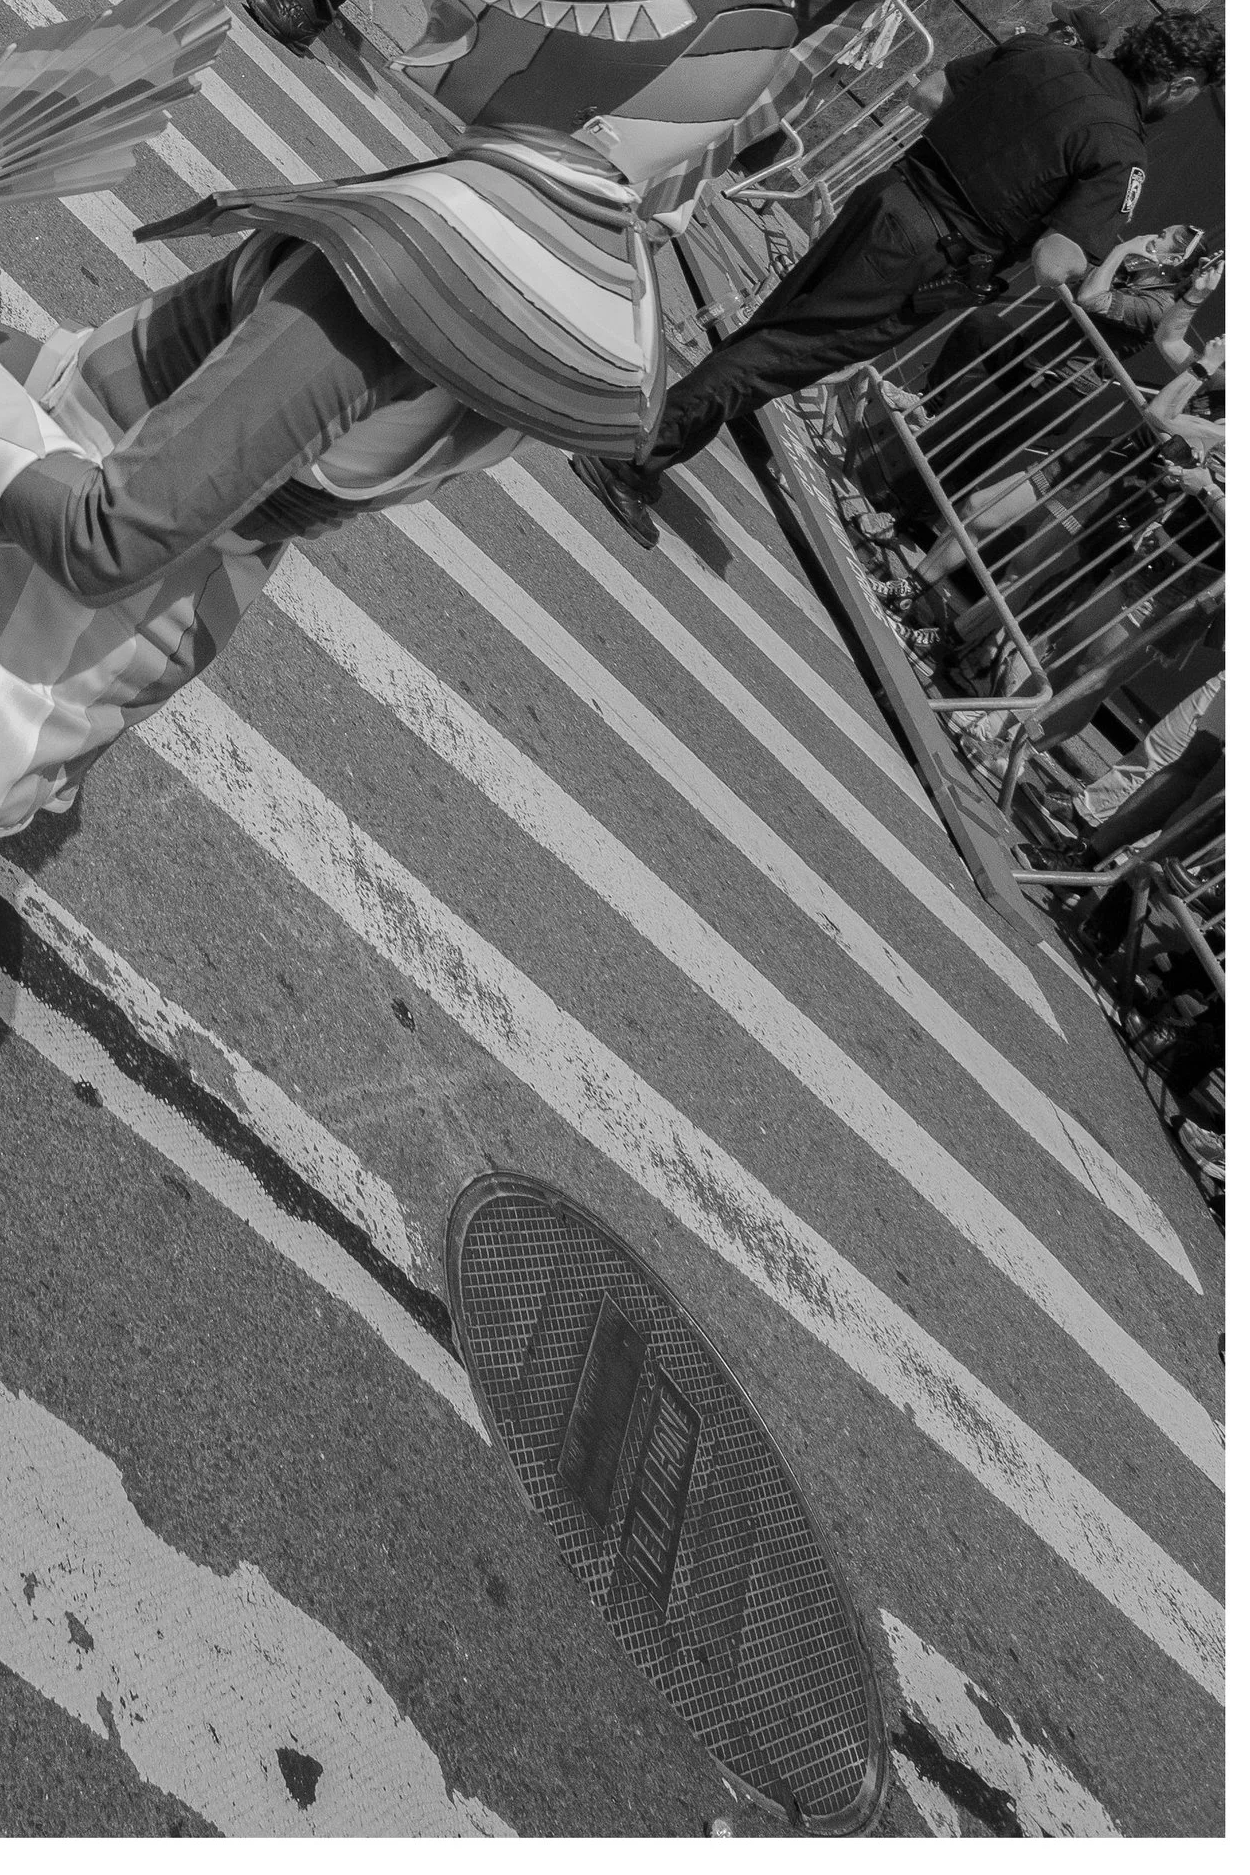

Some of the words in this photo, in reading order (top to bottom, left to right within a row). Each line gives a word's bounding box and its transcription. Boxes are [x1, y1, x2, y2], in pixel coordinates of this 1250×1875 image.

[779, 435, 814, 495] NYPD
[781, 422, 813, 468] LINE
[811, 483, 835, 516] DO
[824, 513, 857, 560] NOT
[846, 556, 889, 626] CROSS
[624, 1383, 693, 1590] TELEPHONE
